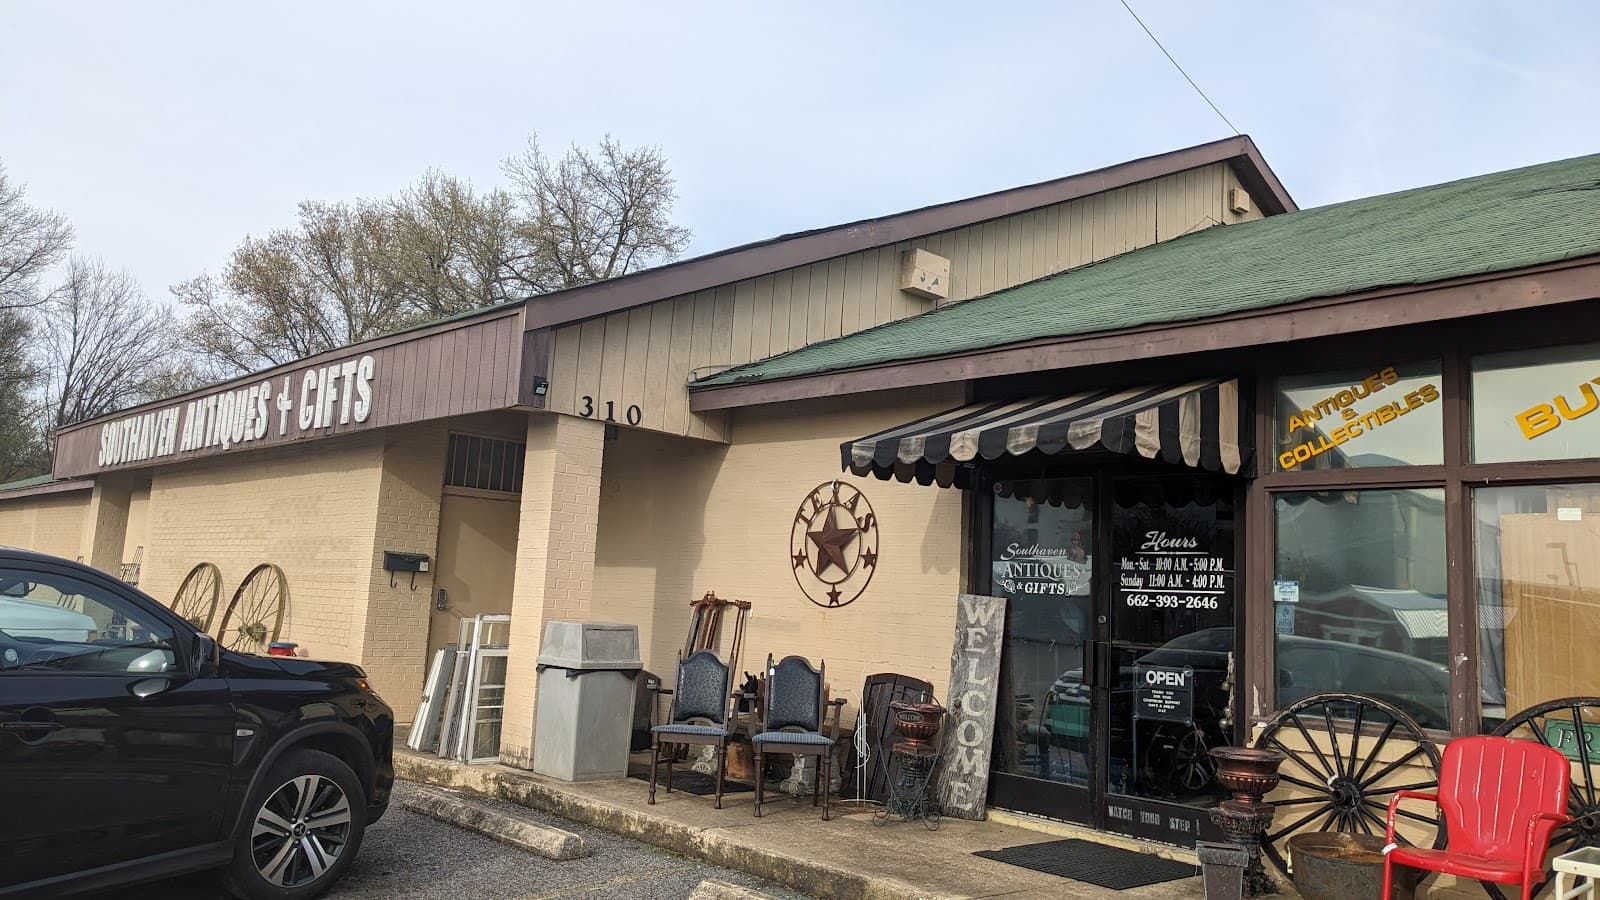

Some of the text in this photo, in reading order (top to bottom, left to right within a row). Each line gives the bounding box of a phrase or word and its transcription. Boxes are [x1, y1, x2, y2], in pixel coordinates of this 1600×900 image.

[1288, 366, 1400, 433] ANTIQUES
[1515, 377, 1600, 440] BU
[99, 406, 180, 467] SOUTHAVEN
[180, 380, 272, 450] ANTIQUES
[299, 355, 376, 431] GIFTS
[579, 395, 642, 426] 310
[1341, 408, 1359, 421] &
[1279, 384, 1440, 470] COLLECTIBLES
[1141, 531, 1198, 551] Hours
[1001, 543, 1067, 561] Southaven
[1001, 562, 1081, 581] ANTIQUES
[1155, 557, 1172, 571] 10:00
[1209, 558, 1224, 571] P.M.
[1025, 582, 1065, 595] GIFTS
[1120, 573, 1144, 589] Sunday
[1149, 574, 1166, 587] 11:00
[1167, 574, 1183, 587] A.M.
[1192, 574, 1207, 588] 4:00
[1209, 574, 1225, 588] P.M.
[1126, 594, 1218, 609] 662-393-2646
[1145, 670, 1185, 687] OPEN
[949, 598, 996, 811] WELCOME
[1107, 804, 1133, 821] WATCH
[1140, 810, 1161, 826] YOUR
[1168, 817, 1191, 832] STEP
